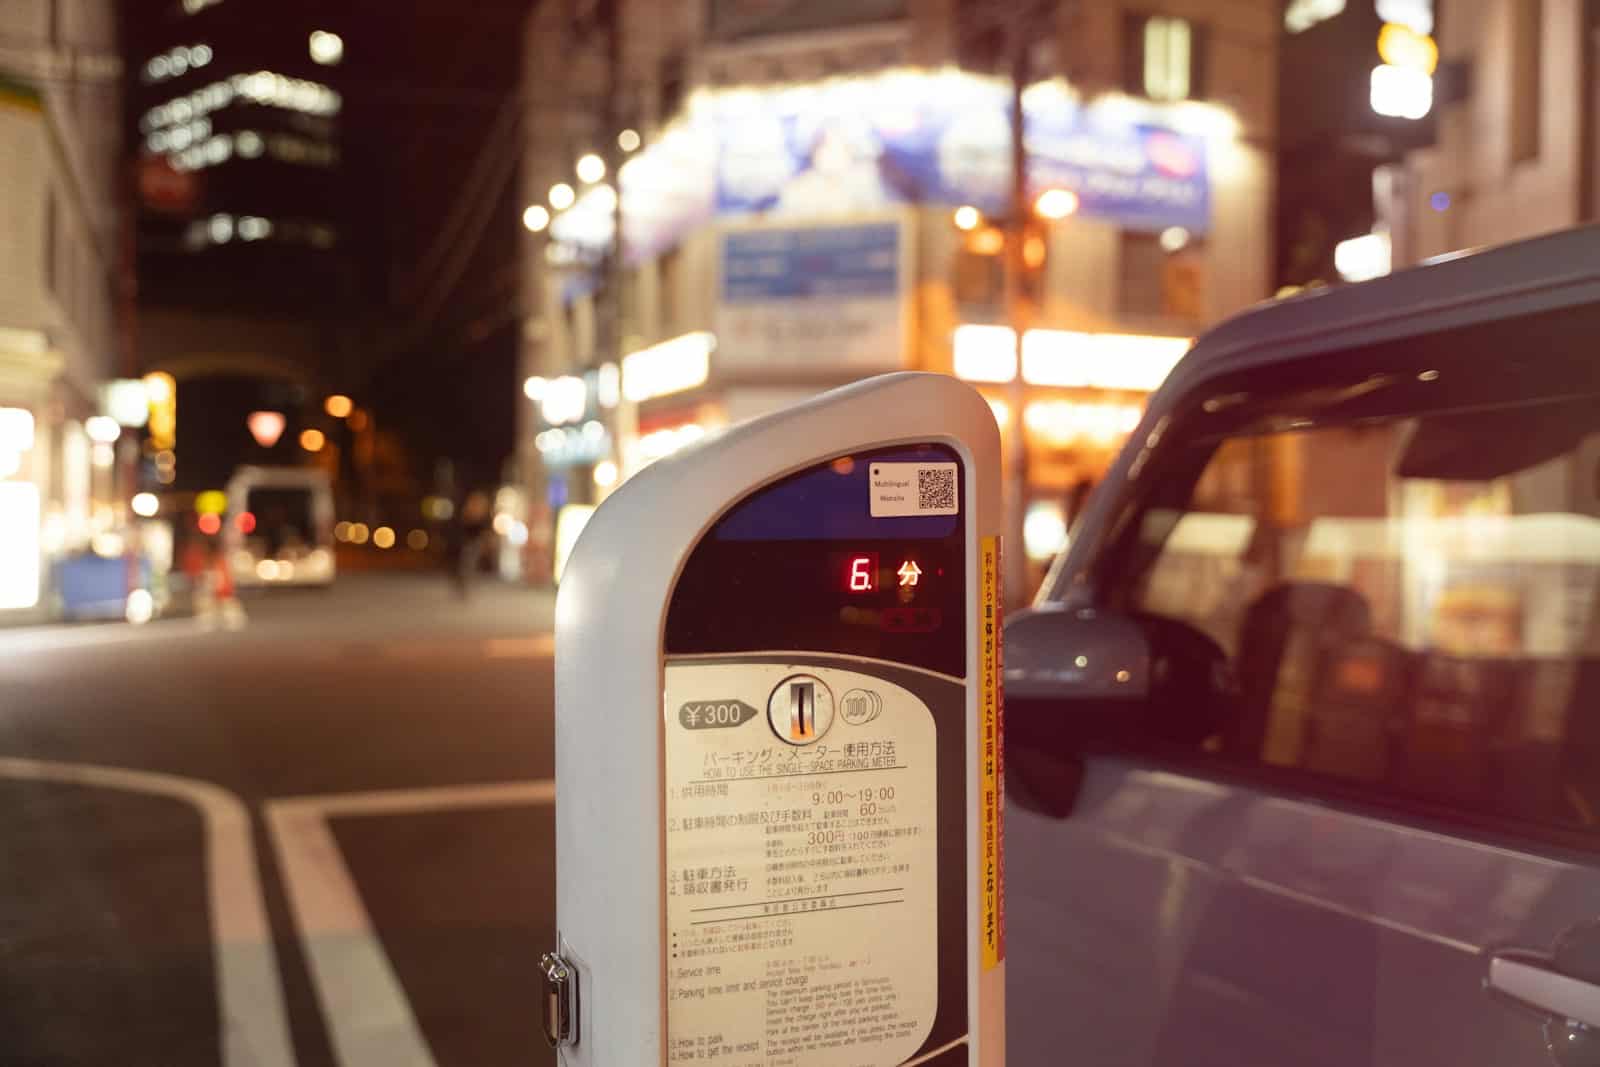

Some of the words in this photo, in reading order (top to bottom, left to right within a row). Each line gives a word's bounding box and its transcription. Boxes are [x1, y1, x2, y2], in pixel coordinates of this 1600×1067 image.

[897, 560, 922, 586] 分
[704, 768, 723, 778] HOW
[726, 767, 737, 777] TO
[740, 766, 756, 776] USE
[760, 764, 773, 775] THE
[838, 758, 870, 769] PARKING
[872, 757, 897, 767] METER
[785, 975, 809, 987] charge
